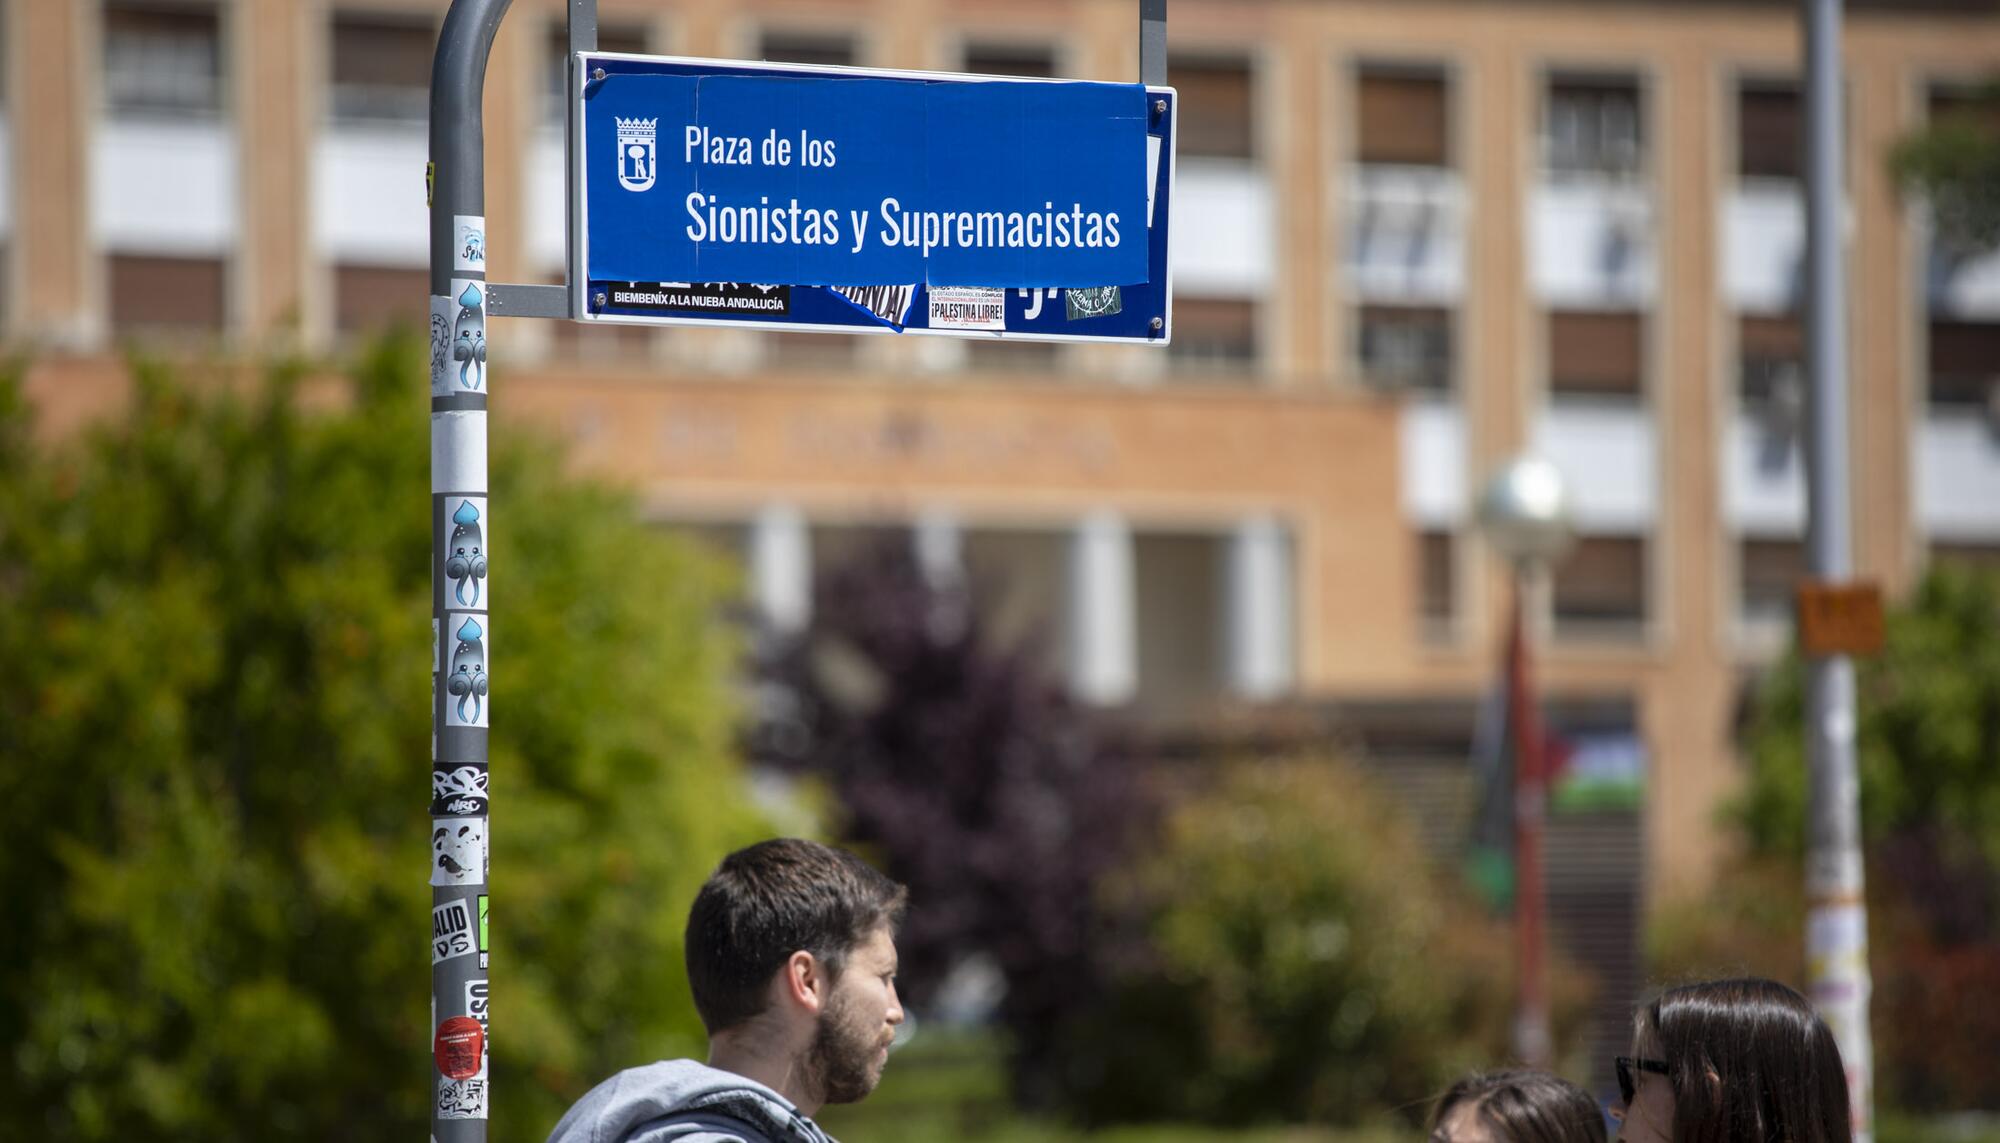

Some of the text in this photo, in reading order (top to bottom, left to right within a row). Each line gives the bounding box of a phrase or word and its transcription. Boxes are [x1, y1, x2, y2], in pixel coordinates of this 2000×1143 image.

[685, 125, 836, 168] Plaza de los
[686, 192, 1121, 258] Sionistas y Supremacistas
[614, 291, 784, 310] BIEMBENÍX A LA NUEBA ANDALUCÍA
[931, 303, 1003, 319] ¡PALESTINA LIBRE!
[432, 905, 467, 941] ALID
